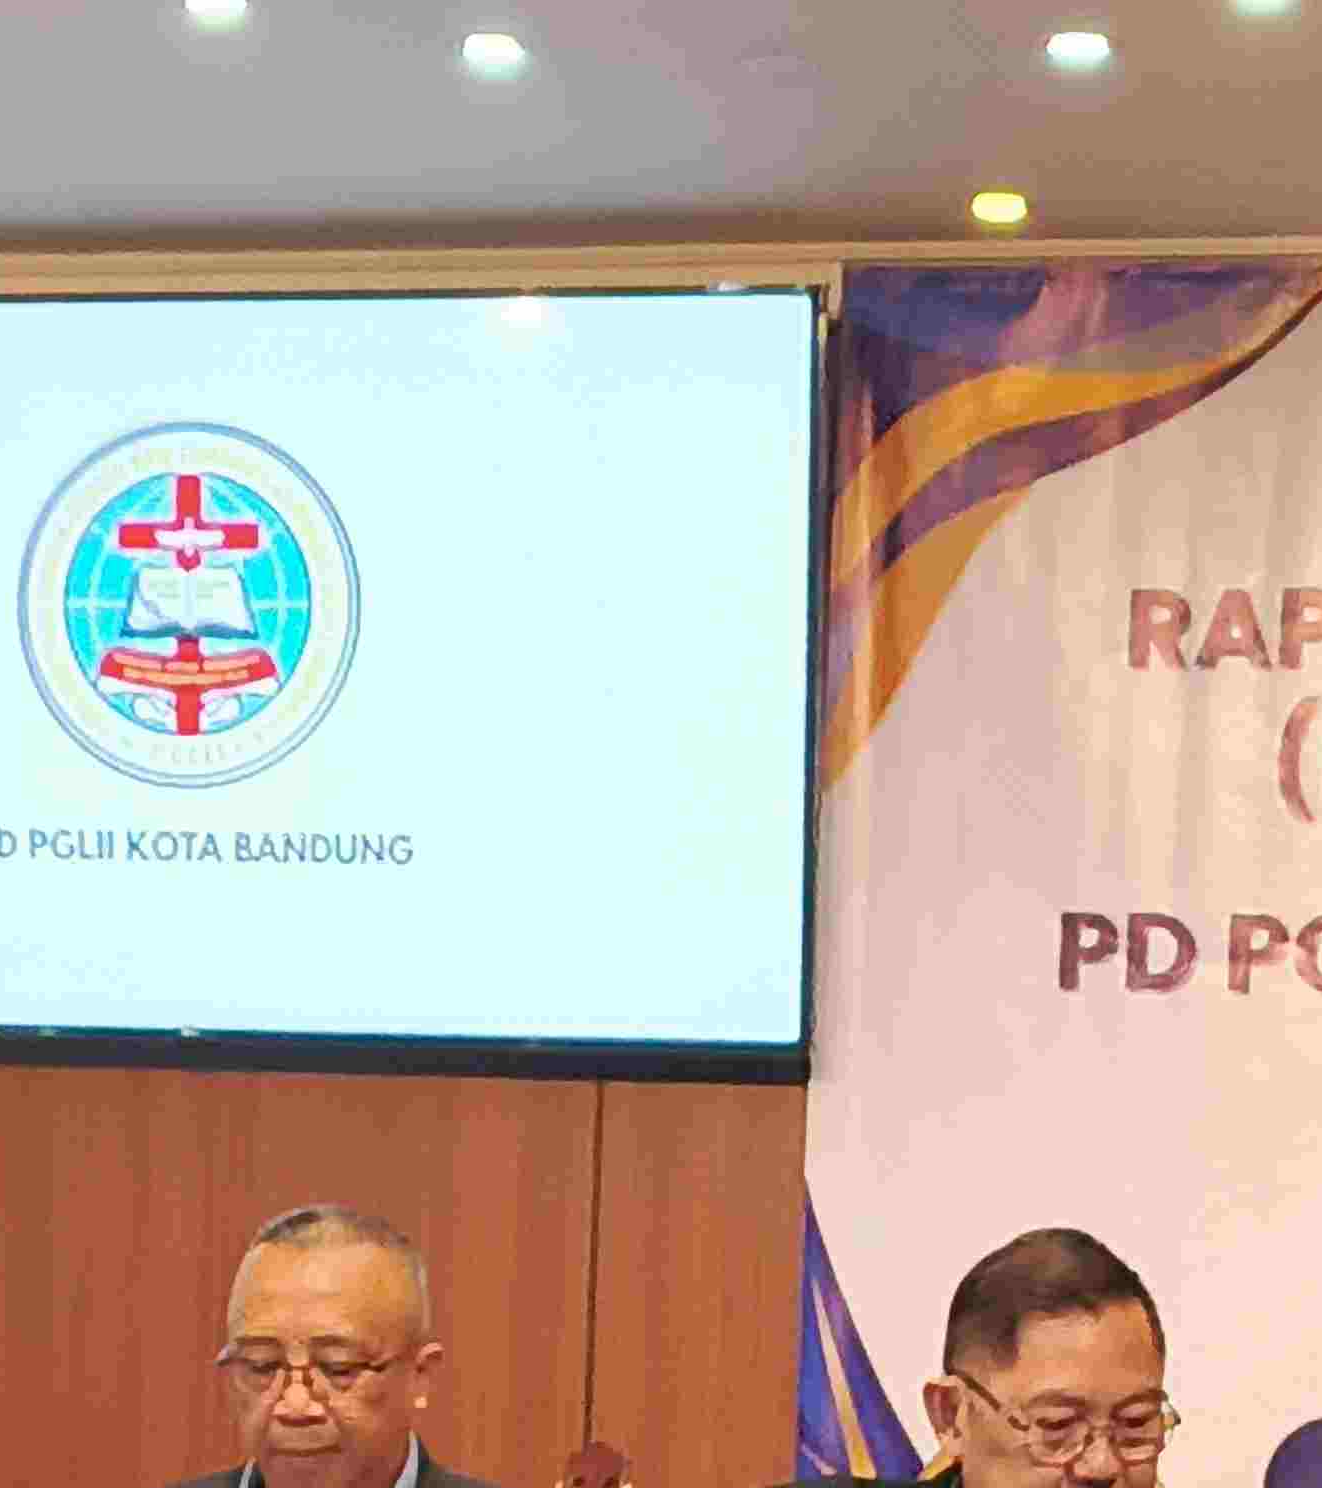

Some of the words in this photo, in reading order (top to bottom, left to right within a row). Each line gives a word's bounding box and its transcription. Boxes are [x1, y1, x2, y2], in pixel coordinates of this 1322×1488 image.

[28, 828, 115, 861] PGLII
[126, 829, 223, 863] KOTA
[233, 831, 415, 865] BANDUNG
[1057, 911, 1199, 994] PD
